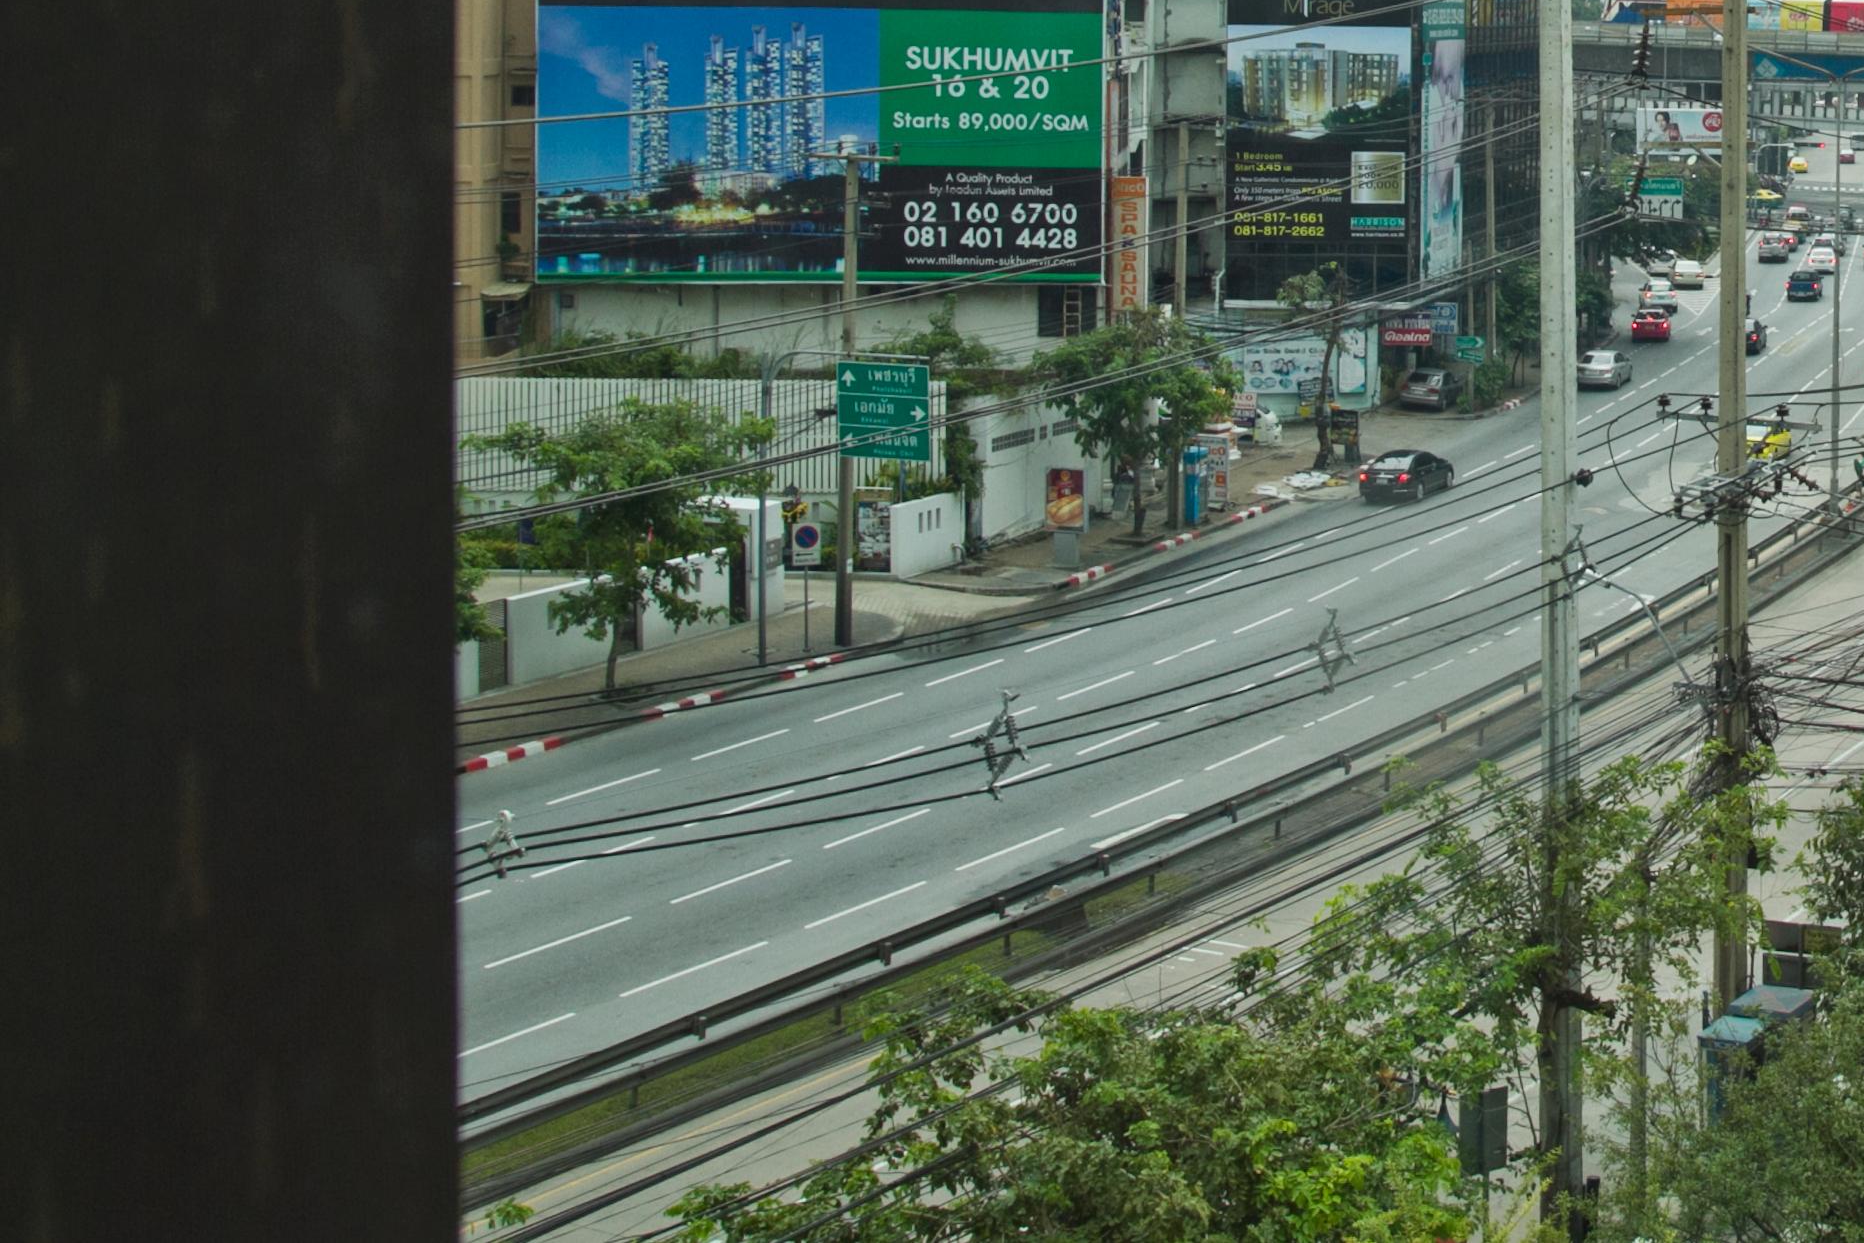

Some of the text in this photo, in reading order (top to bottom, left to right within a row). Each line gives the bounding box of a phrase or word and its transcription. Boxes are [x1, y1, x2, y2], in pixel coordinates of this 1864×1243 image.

[905, 45, 1074, 72] SUKHUMVIT
[932, 73, 1050, 100] 16 & 20
[892, 111, 1089, 132] Starts 89,000/SQM
[1243, 151, 1284, 160] Bedroom
[1234, 163, 1255, 172] Start
[945, 172, 1033, 186] A Quality Product
[928, 182, 943, 198] by
[985, 183, 1016, 196] Assets
[1019, 184, 1054, 197] Limited
[903, 200, 1078, 225] 02 160 6700
[1120, 201, 1138, 235] SPA
[903, 225, 1078, 250] 081 401 4428
[1233, 225, 1325, 237] 081-817-2662
[1119, 251, 1138, 307] SAUNA
[854, 397, 895, 415] เอกมัย
